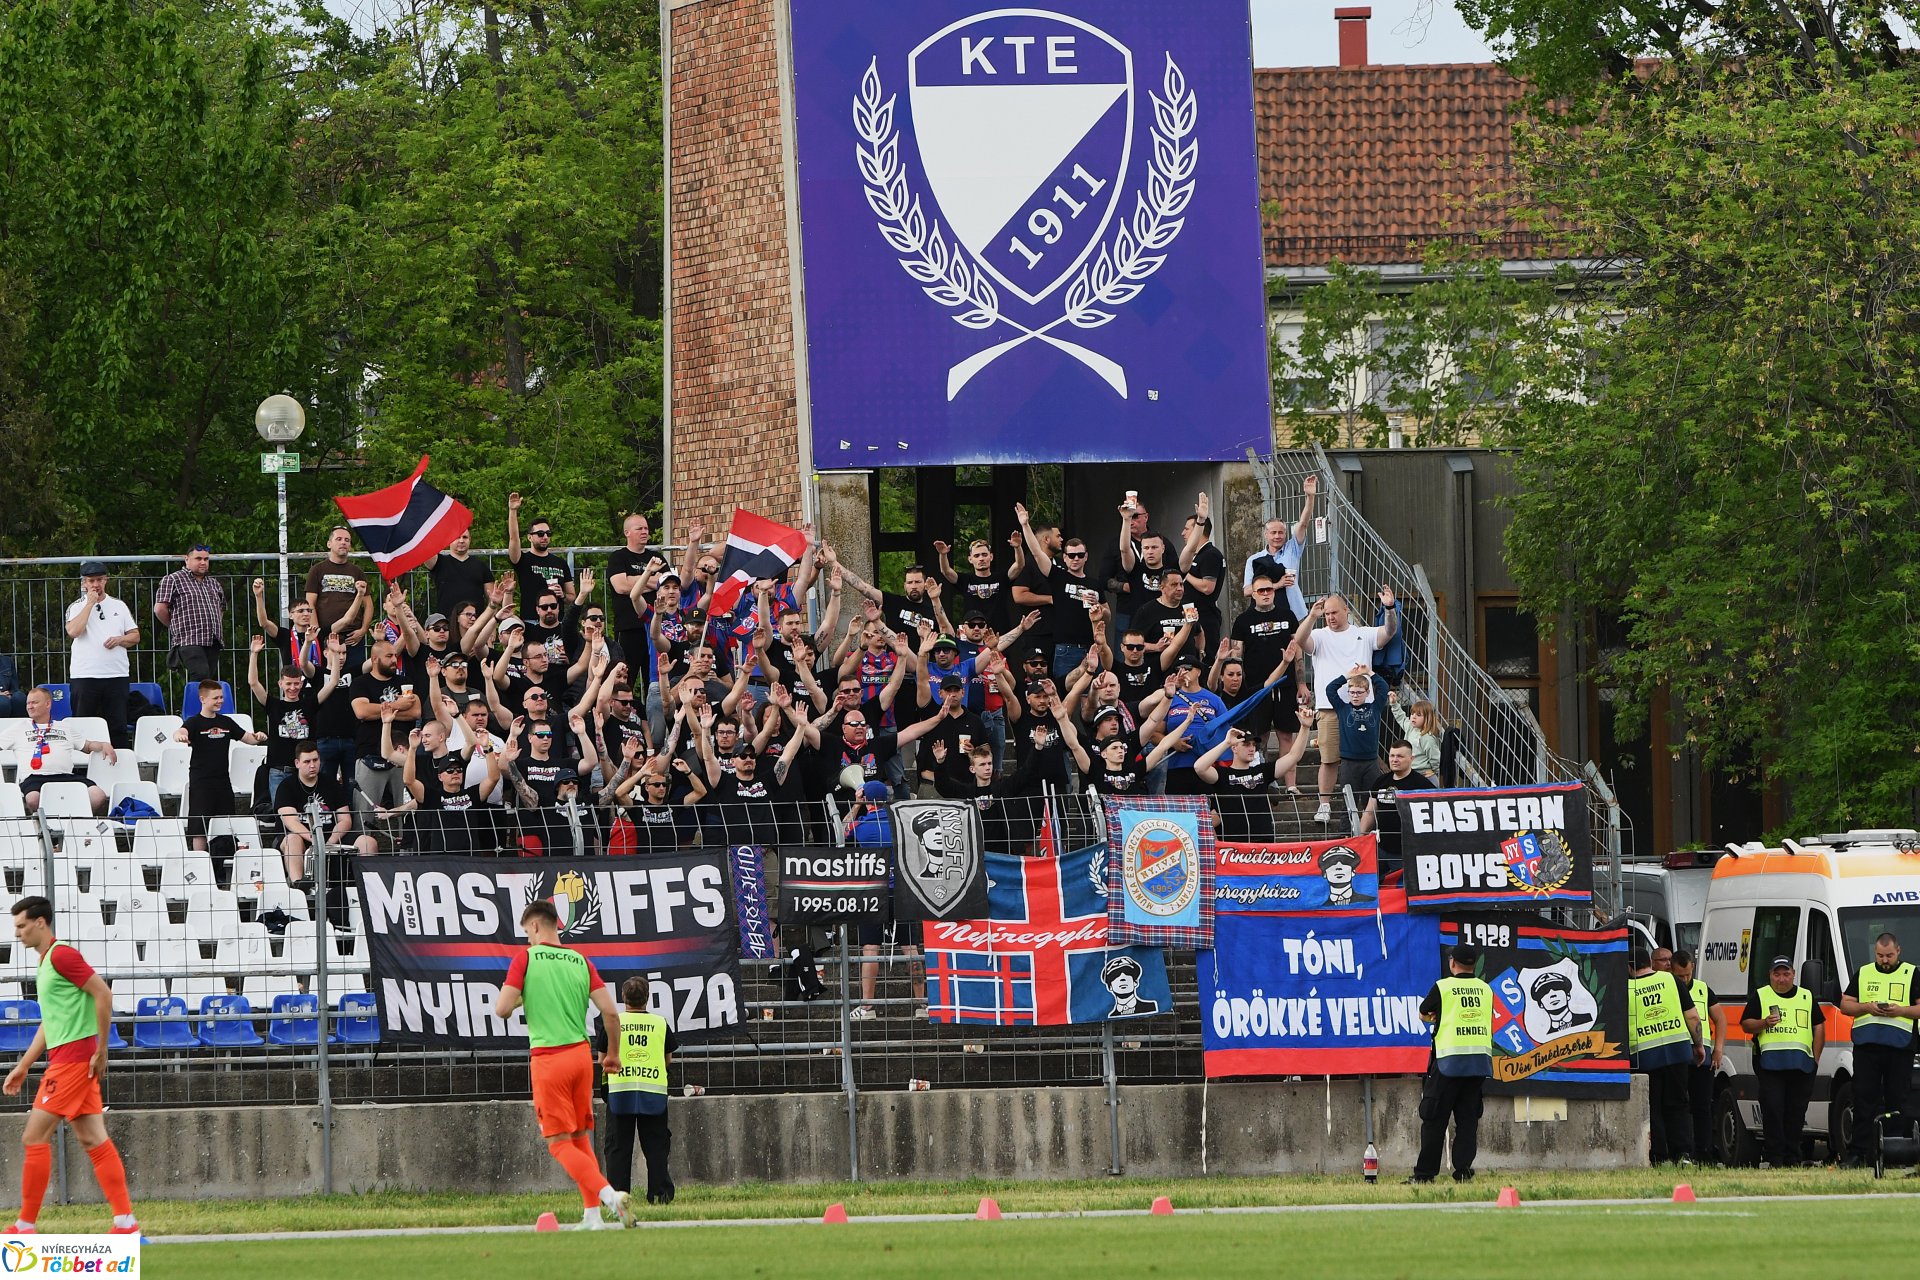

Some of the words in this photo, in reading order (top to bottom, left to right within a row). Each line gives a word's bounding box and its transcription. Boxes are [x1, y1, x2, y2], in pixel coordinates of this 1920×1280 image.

[961, 36, 1079, 75] KTE
[1008, 163, 1107, 270] 1911
[693, 610, 699, 618] P
[1409, 795, 1564, 833] EASTERN
[940, 809, 965, 880] NYSFC
[785, 853, 886, 878] mastiffs
[1416, 853, 1508, 891] BOYS
[1130, 883, 1154, 910] MUNKA
[1151, 885, 1172, 893] 1905
[1215, 884, 1300, 904] íregyháza
[1873, 891, 1920, 904] AMB
[402, 880, 416, 929] 1995
[793, 896, 879, 912] 1995.08.12
[1463, 923, 1510, 947] 1928
[535, 952, 583, 966] macron
[1282, 929, 1363, 981] TÓNI,
[1705, 942, 1737, 961] OKTOMED
[1452, 988, 1484, 996] SECURITY
[1634, 982, 1665, 997] SECURITY
[1461, 996, 1481, 1008] 089
[1643, 993, 1662, 1007] 022
[1212, 986, 1322, 1039] ÖRÖKKÉ
[621, 1024, 655, 1033] SECURITY
[628, 1034, 648, 1047] 048
[1504, 1061, 1532, 1076] Vén
[1531, 1034, 1593, 1068] Tinédzserek
